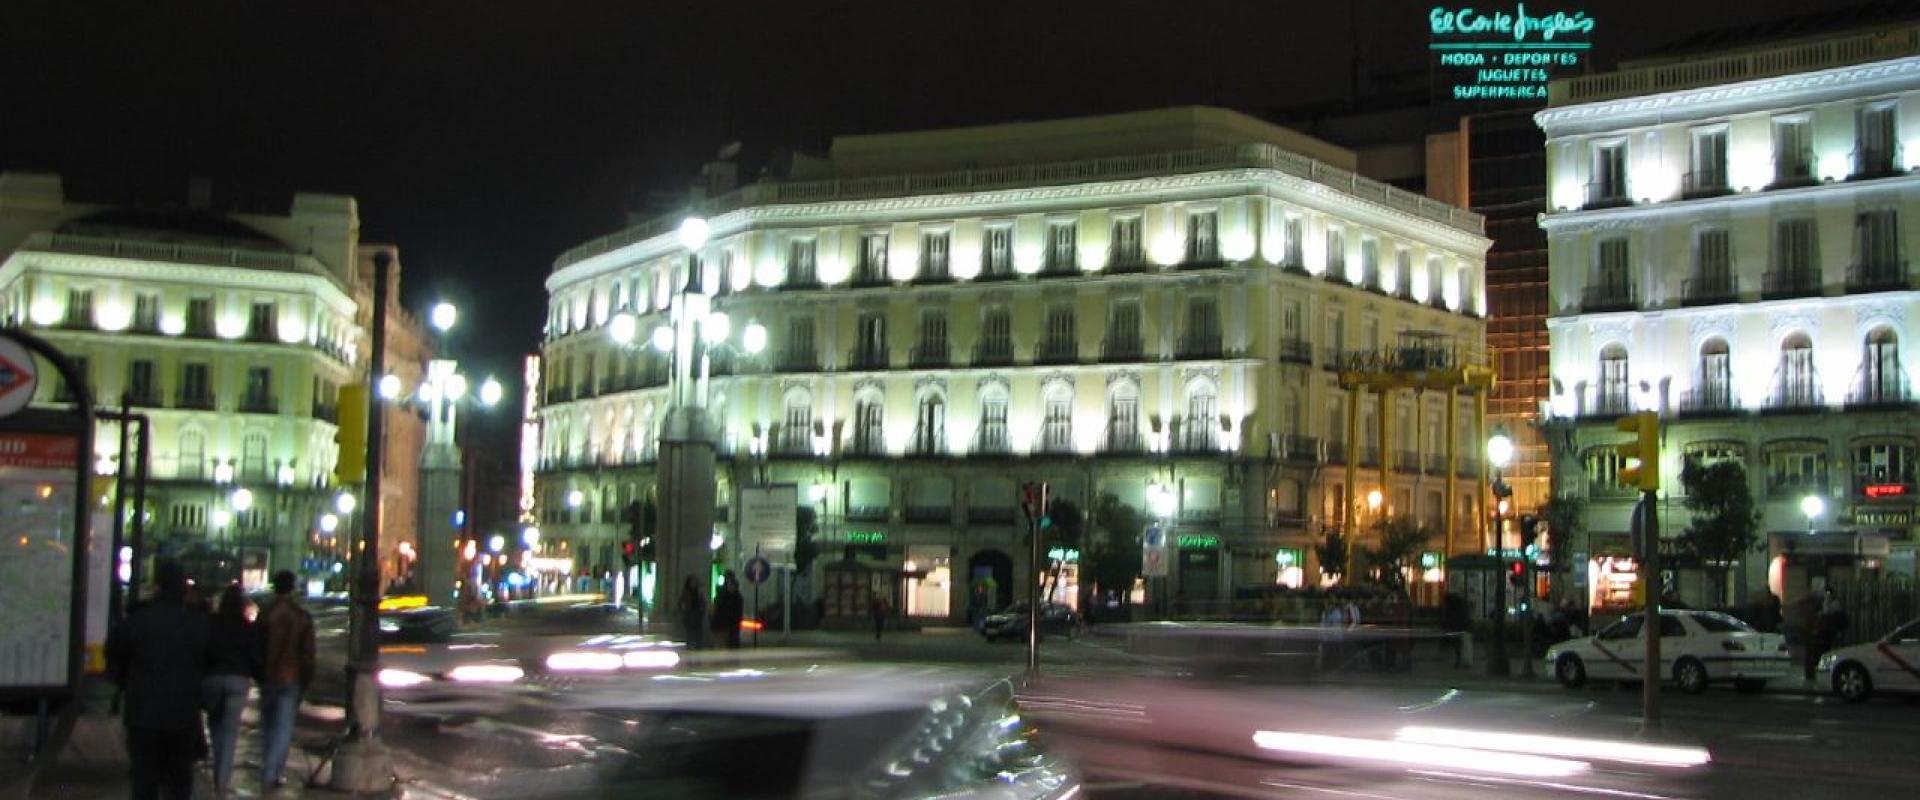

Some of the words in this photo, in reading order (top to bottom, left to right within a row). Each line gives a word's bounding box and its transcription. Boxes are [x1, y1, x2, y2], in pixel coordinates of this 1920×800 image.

[1430, 7, 1455, 34] El
[1456, 8, 1512, 33] Corte
[1441, 53, 1485, 65] MODA
[1504, 53, 1577, 65] DEPORTES
[1478, 68, 1547, 82] JUGUETES
[1856, 512, 1908, 525] PALAZZO
